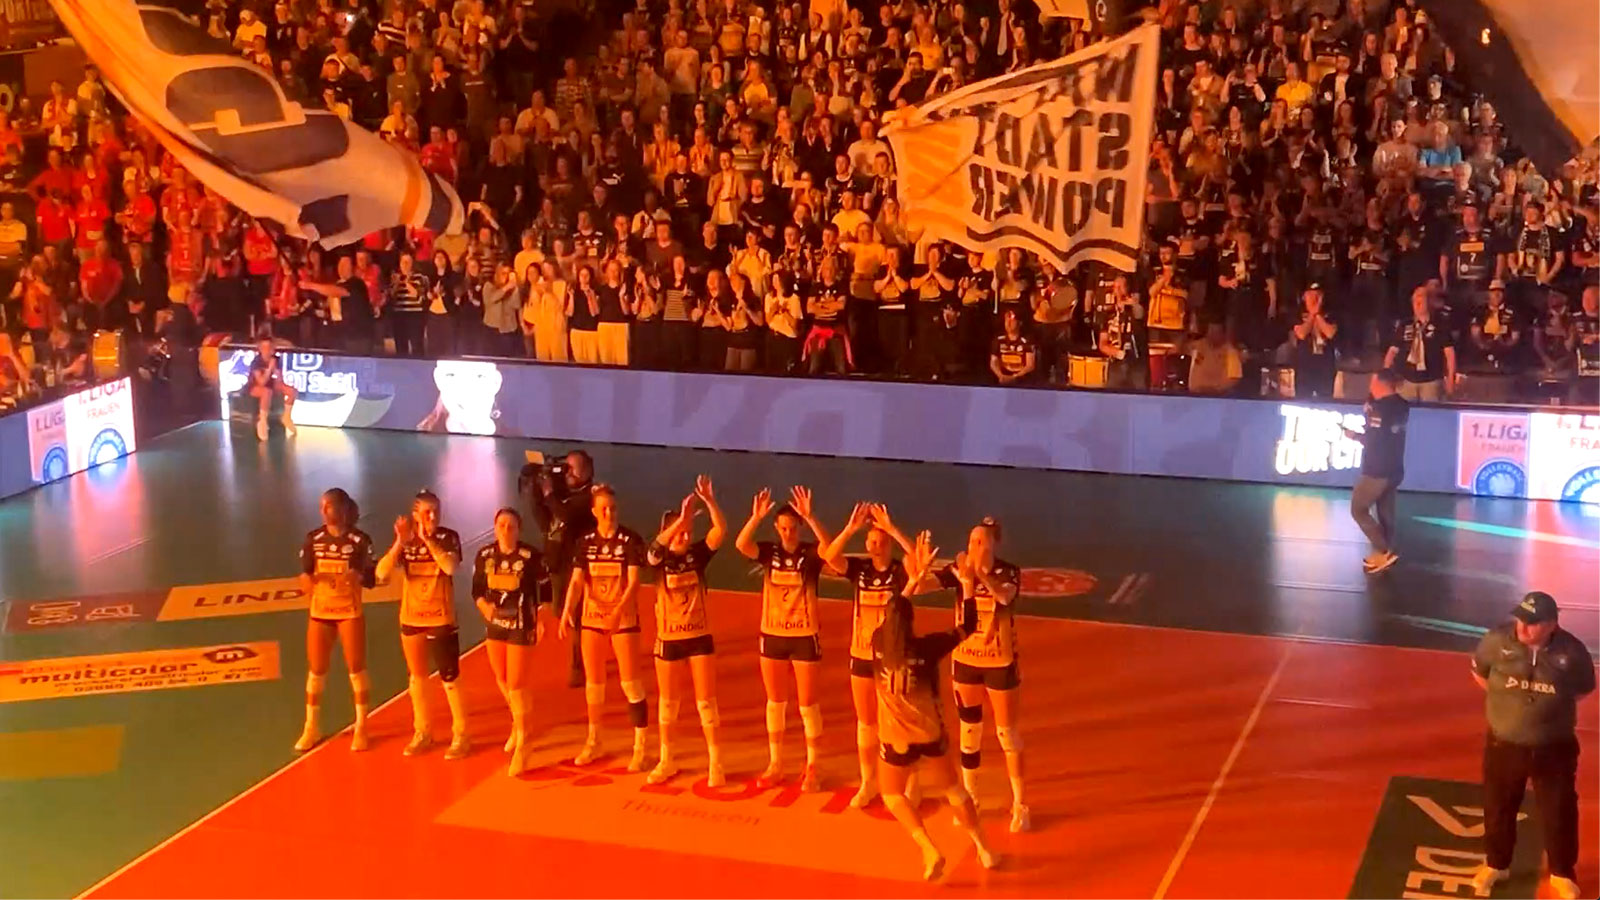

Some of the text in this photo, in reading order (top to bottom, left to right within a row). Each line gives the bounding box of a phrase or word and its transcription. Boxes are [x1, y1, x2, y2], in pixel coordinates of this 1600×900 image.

[1487, 423, 1528, 441] LIG
[193, 588, 307, 608] LIND
[20, 662, 198, 685] multicolor
[1402, 846, 1492, 899] DE
